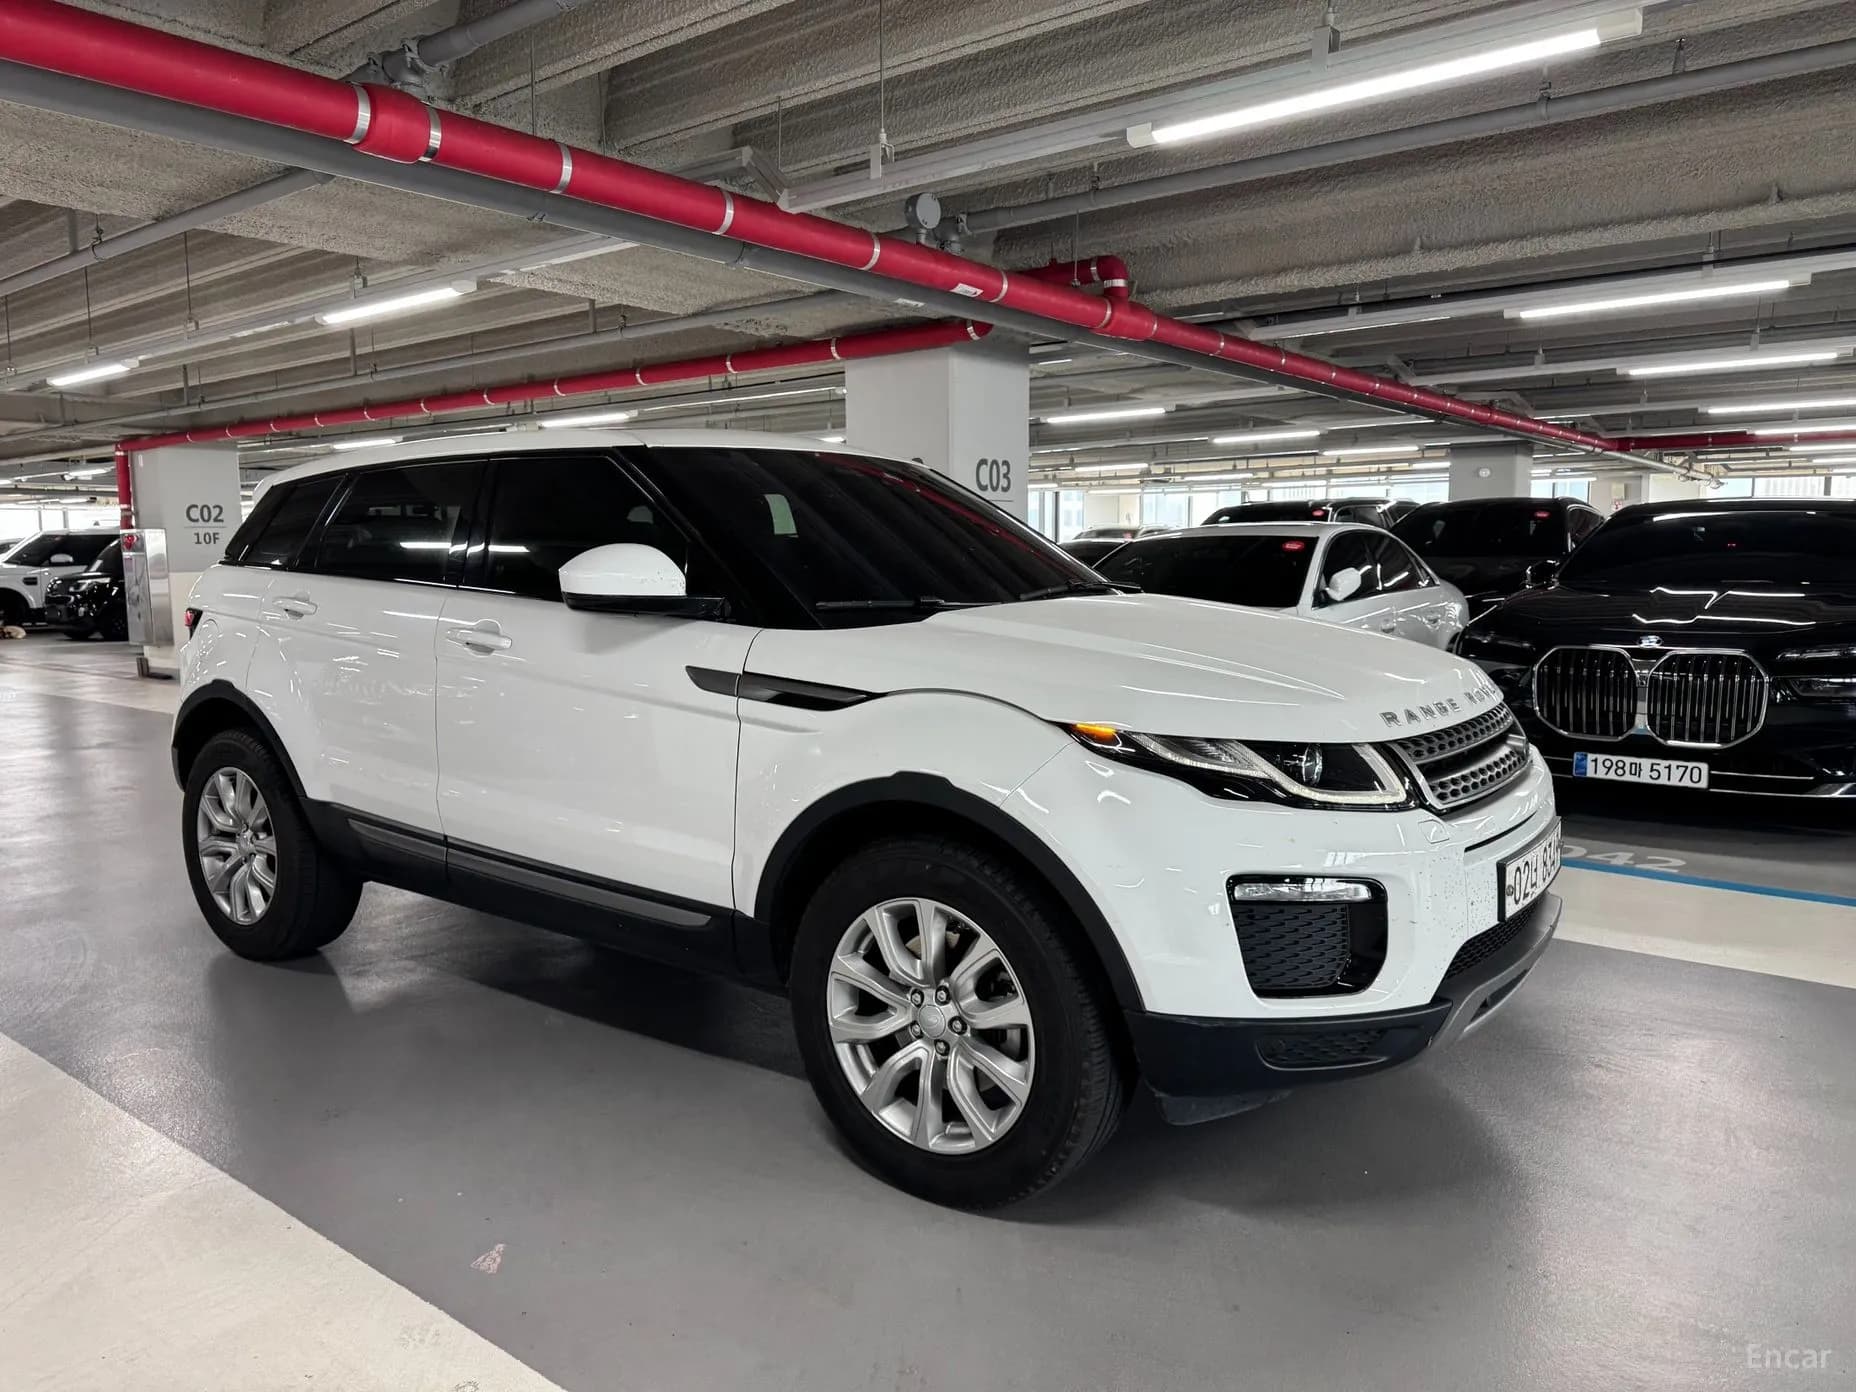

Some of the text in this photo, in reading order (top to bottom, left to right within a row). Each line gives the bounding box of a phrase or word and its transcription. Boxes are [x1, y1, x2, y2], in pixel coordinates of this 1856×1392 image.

[975, 458, 1012, 493] C03
[185, 504, 225, 523] C02
[194, 532, 220, 545] 10F
[1379, 697, 1462, 728] RANGE
[1590, 756, 1702, 784] 198마 5170
